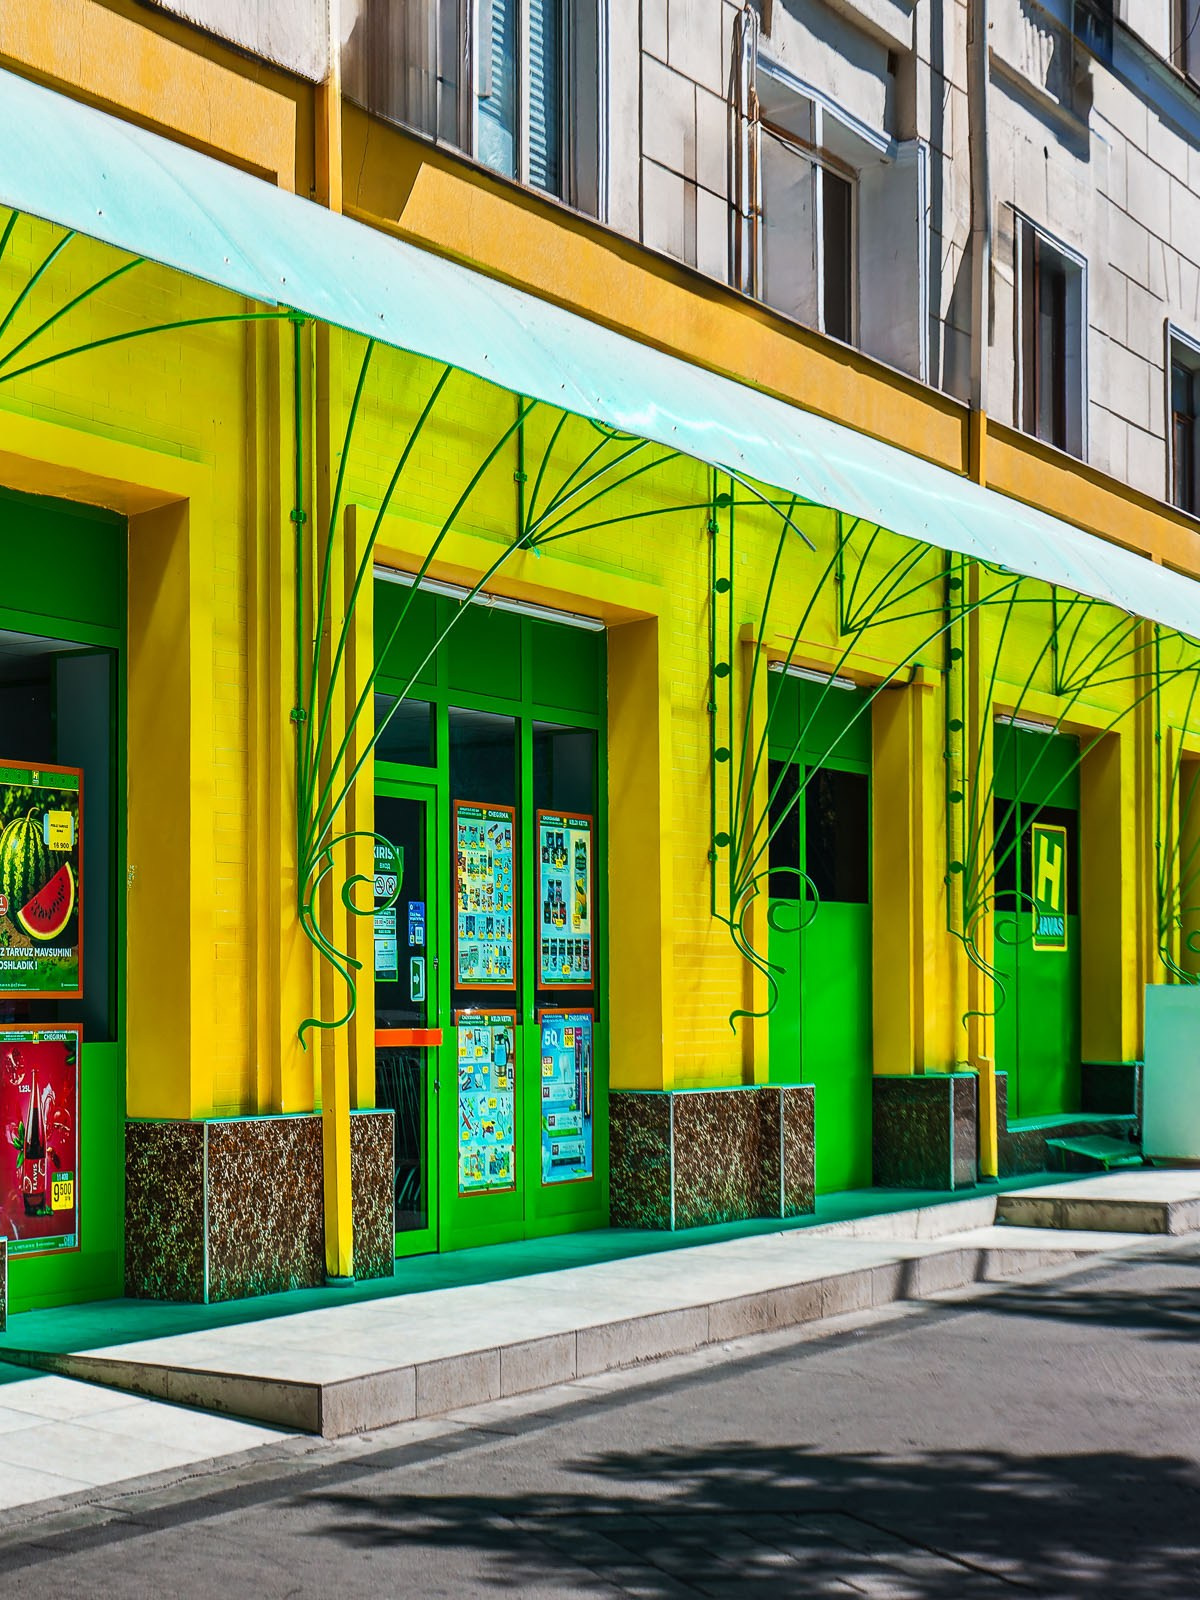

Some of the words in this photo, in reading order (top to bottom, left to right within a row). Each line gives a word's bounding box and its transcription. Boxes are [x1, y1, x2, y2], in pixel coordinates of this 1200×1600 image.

[1037, 834, 1062, 911] H
[5, 947, 33, 957] TARVUZ
[34, 947, 72, 958] MAVSUMINI
